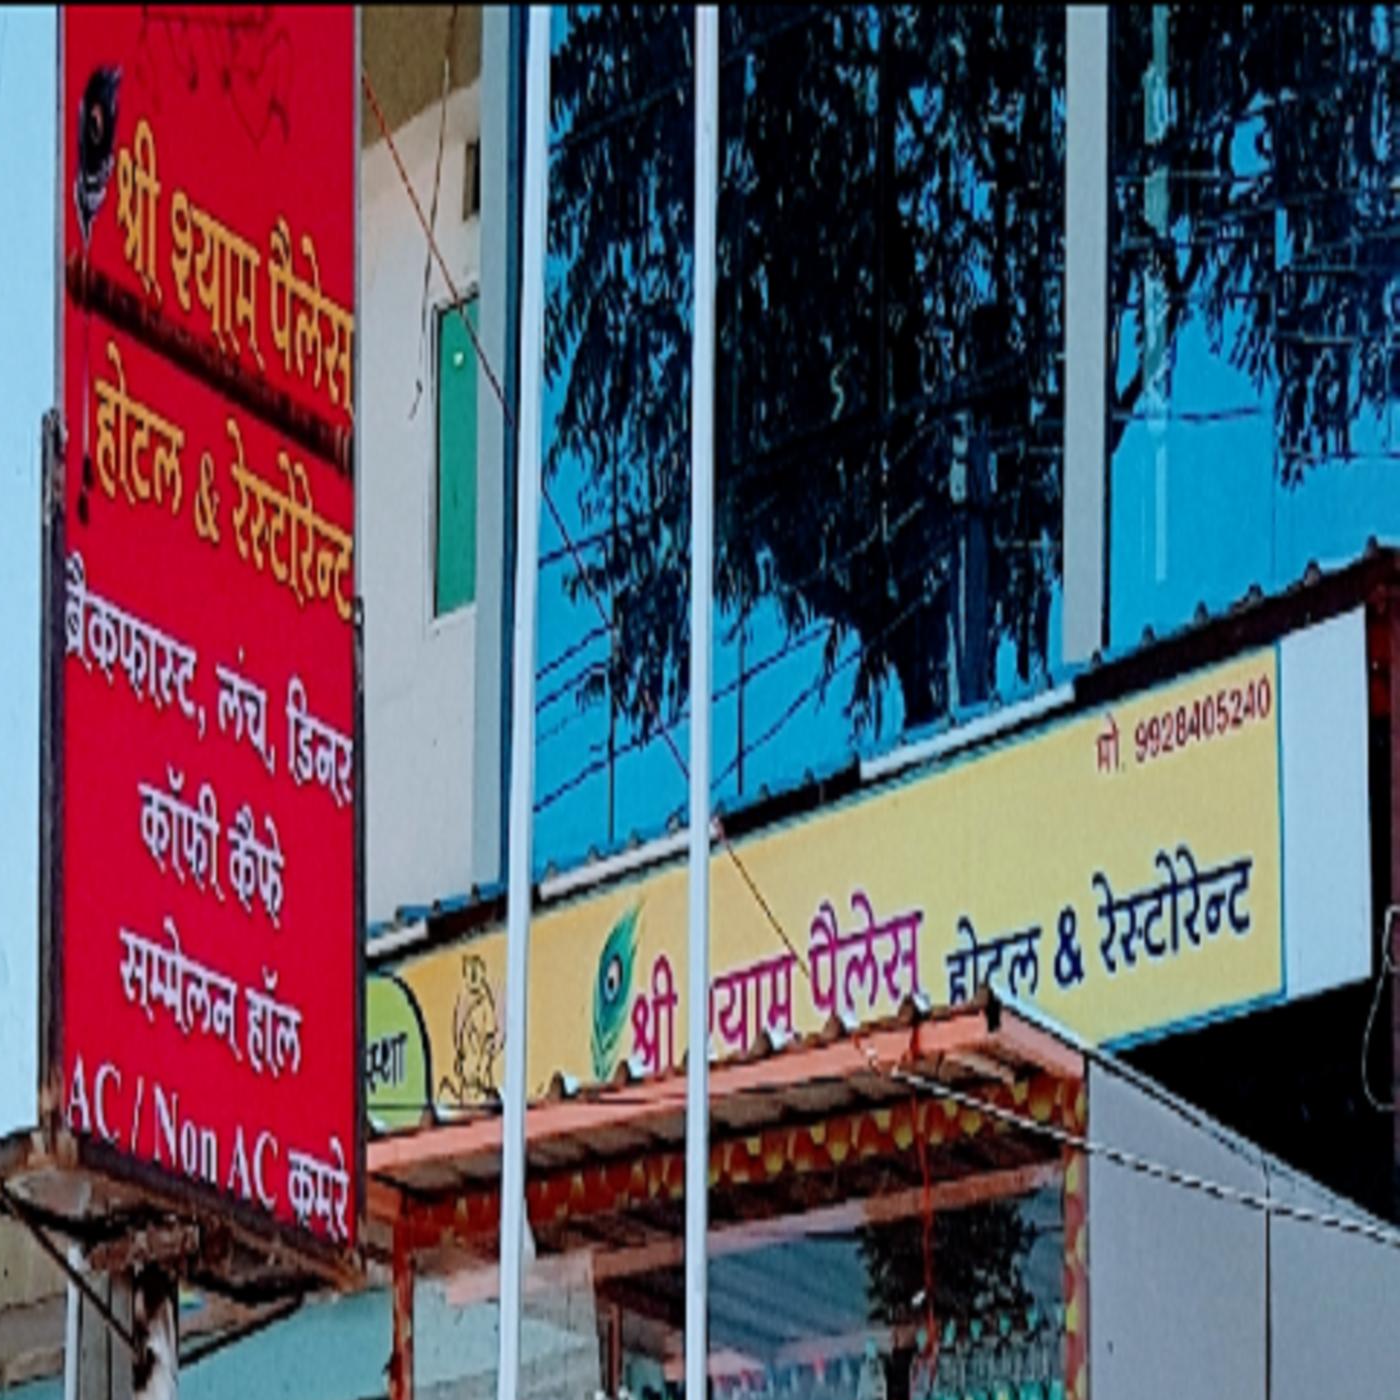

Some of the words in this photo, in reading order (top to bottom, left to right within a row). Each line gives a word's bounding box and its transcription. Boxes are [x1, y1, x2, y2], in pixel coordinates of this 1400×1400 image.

[116, 117, 162, 304] श्री
[171, 188, 266, 373] श्याम
[268, 215, 355, 420] पैलेस
[94, 341, 185, 516] होटल
[194, 451, 221, 543] &
[285, 674, 354, 809] डिनर
[1134, 673, 1273, 764] 9928405240
[137, 763, 226, 903] कॉफी
[227, 803, 285, 931] कैफे
[118, 915, 243, 1061] सम्मेलन
[245, 965, 303, 1078] हॉल
[630, 954, 678, 1078] श्री
[707, 950, 799, 1057] याम
[807, 888, 923, 1019] पैलेस
[1054, 904, 1085, 990] &
[1091, 844, 1254, 974] रेस्टोरेन्ट
[66, 1053, 121, 1142] AC
[130, 1076, 145, 1153] /
[153, 1082, 218, 1185] Non
[226, 1125, 279, 1211] AC
[287, 1136, 349, 1243] कमरे
